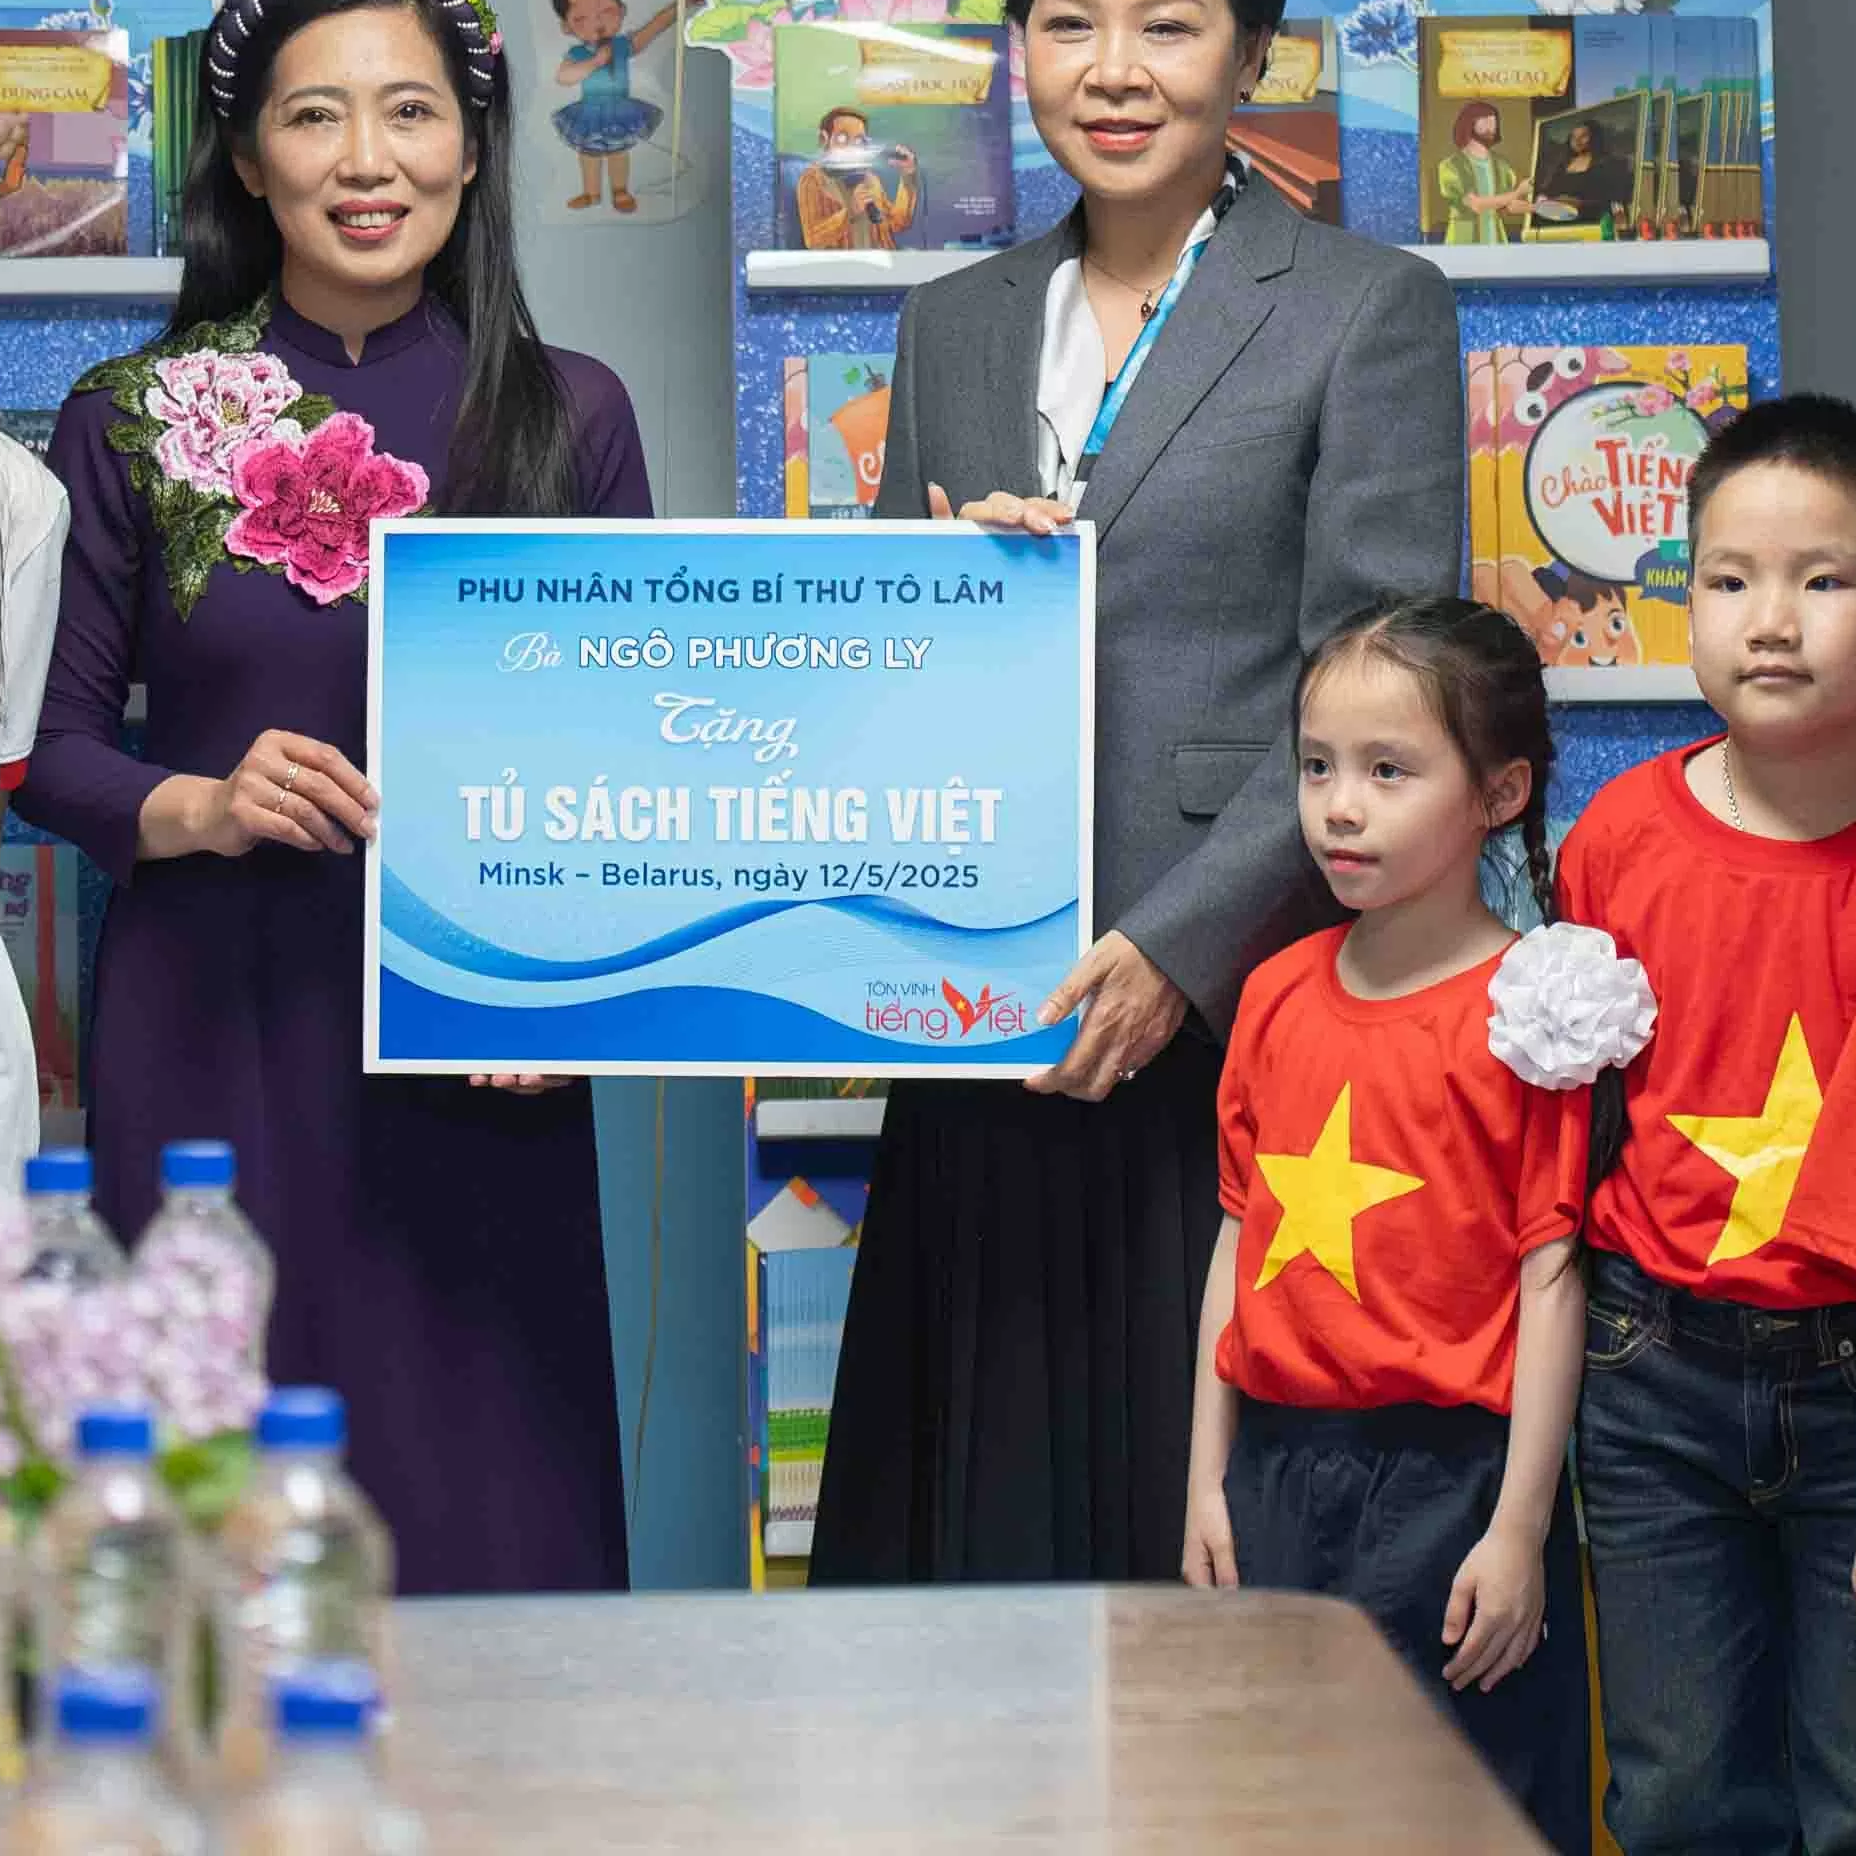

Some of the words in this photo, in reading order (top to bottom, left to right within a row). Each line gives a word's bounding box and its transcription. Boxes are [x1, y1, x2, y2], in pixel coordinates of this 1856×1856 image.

[1541, 464, 1608, 509] Chào
[1592, 490, 1682, 545] VIỆT
[458, 579, 525, 604] PHU
[537, 575, 633, 603] NHÂN
[644, 565, 740, 605] TỔNG
[752, 573, 784, 604] BÍ
[795, 576, 866, 605] THƯ
[876, 574, 922, 605] TÔ
[934, 575, 1005, 605] LÂM
[1646, 565, 1687, 589] KHÁM
[496, 632, 567, 674] Bà
[578, 629, 675, 670] NGÔ
[688, 633, 872, 670] PHƯƠNG
[883, 637, 934, 670] LY
[653, 691, 800, 763] Tặng
[459, 767, 534, 843] TỦ
[545, 773, 690, 843] SÁCH
[708, 769, 869, 843] TIẾNG
[884, 774, 1004, 856] VIỆT
[478, 861, 566, 888] Minsk
[602, 860, 723, 892] Belarus,
[733, 863, 808, 894] ngày
[819, 860, 980, 892] 12/5/2025
[865, 979, 897, 996] TÔN
[900, 982, 936, 997] VINH
[865, 996, 949, 1040] tiếng
